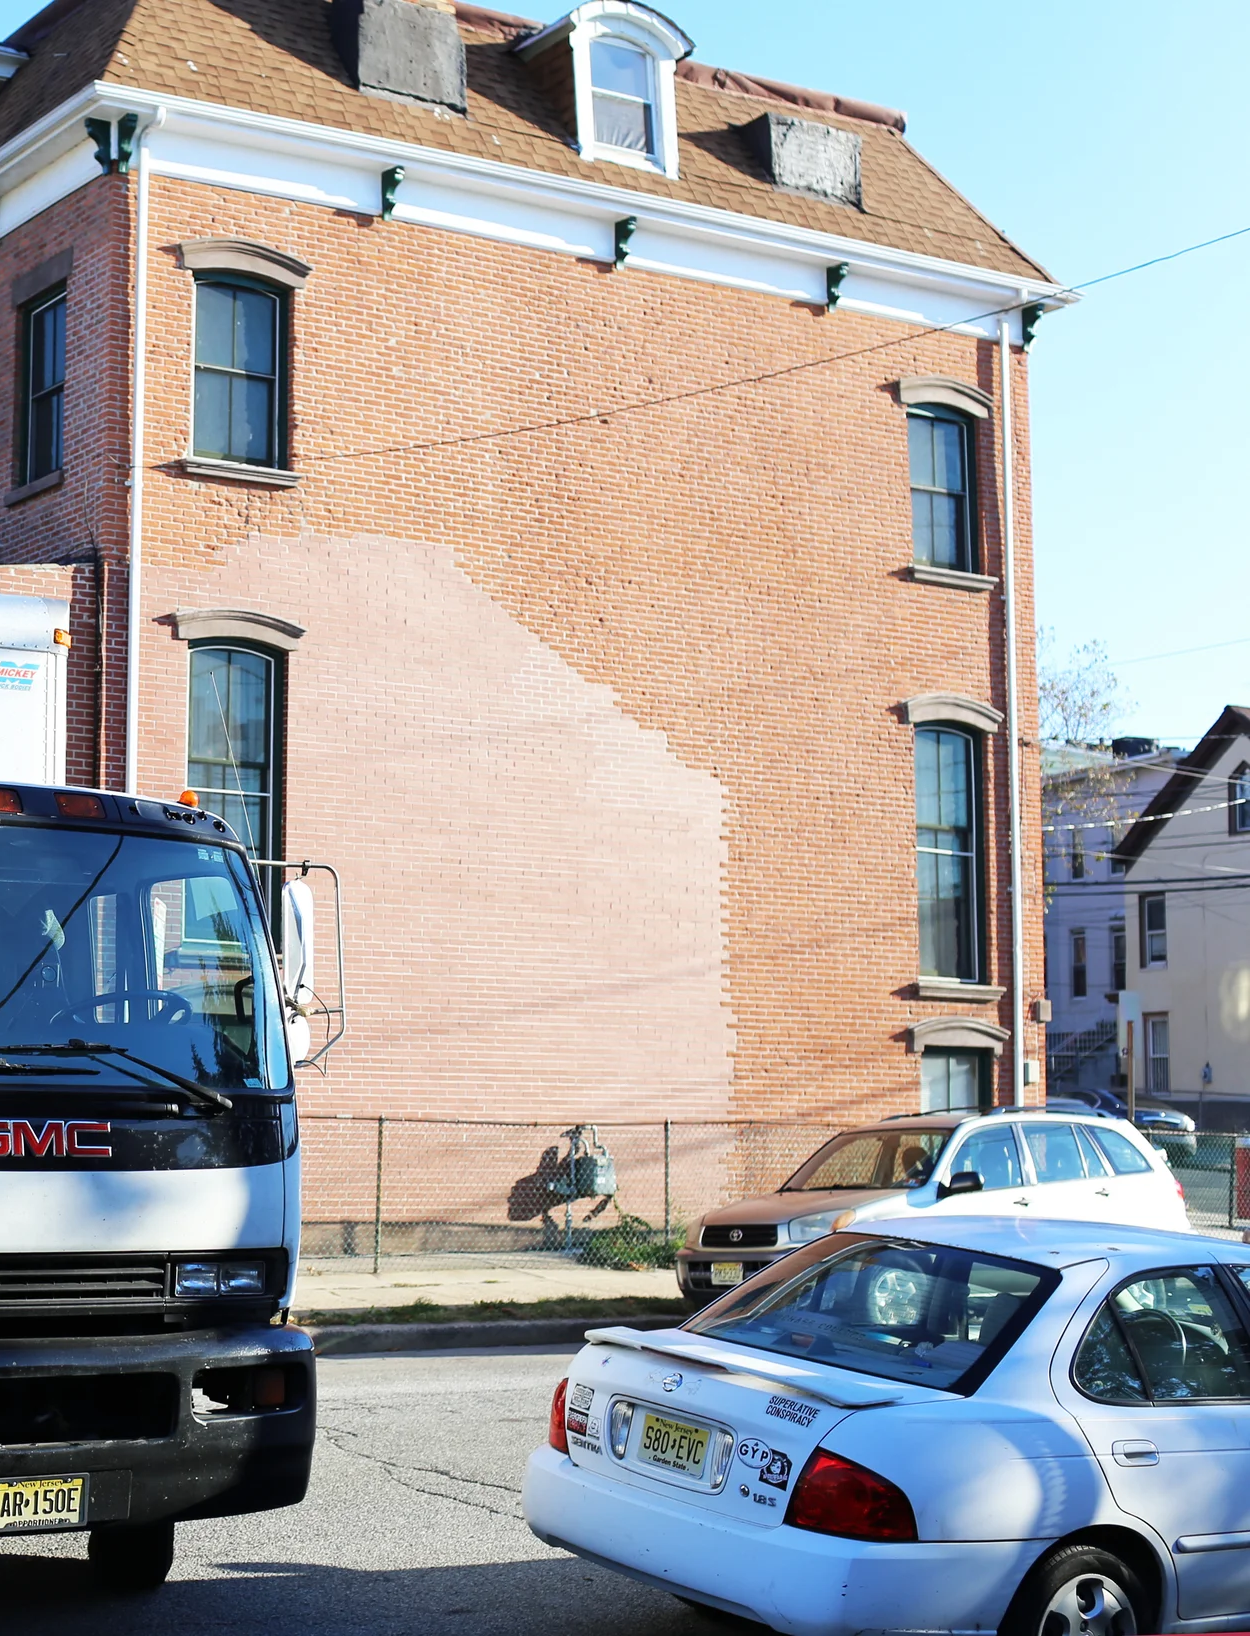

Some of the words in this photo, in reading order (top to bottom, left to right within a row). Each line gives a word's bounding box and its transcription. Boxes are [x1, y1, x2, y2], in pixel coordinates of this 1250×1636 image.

[769, 1395, 821, 1419] SUPERLATIVE
[765, 1405, 813, 1428] CONSPIRACY
[659, 1419, 673, 1429] New
[674, 1423, 693, 1436] Jersey
[652, 1454, 671, 1466] Garden
[672, 1460, 687, 1471] State
[18, 1481, 37, 1489] New
[38, 1479, 64, 1489] Jersey
